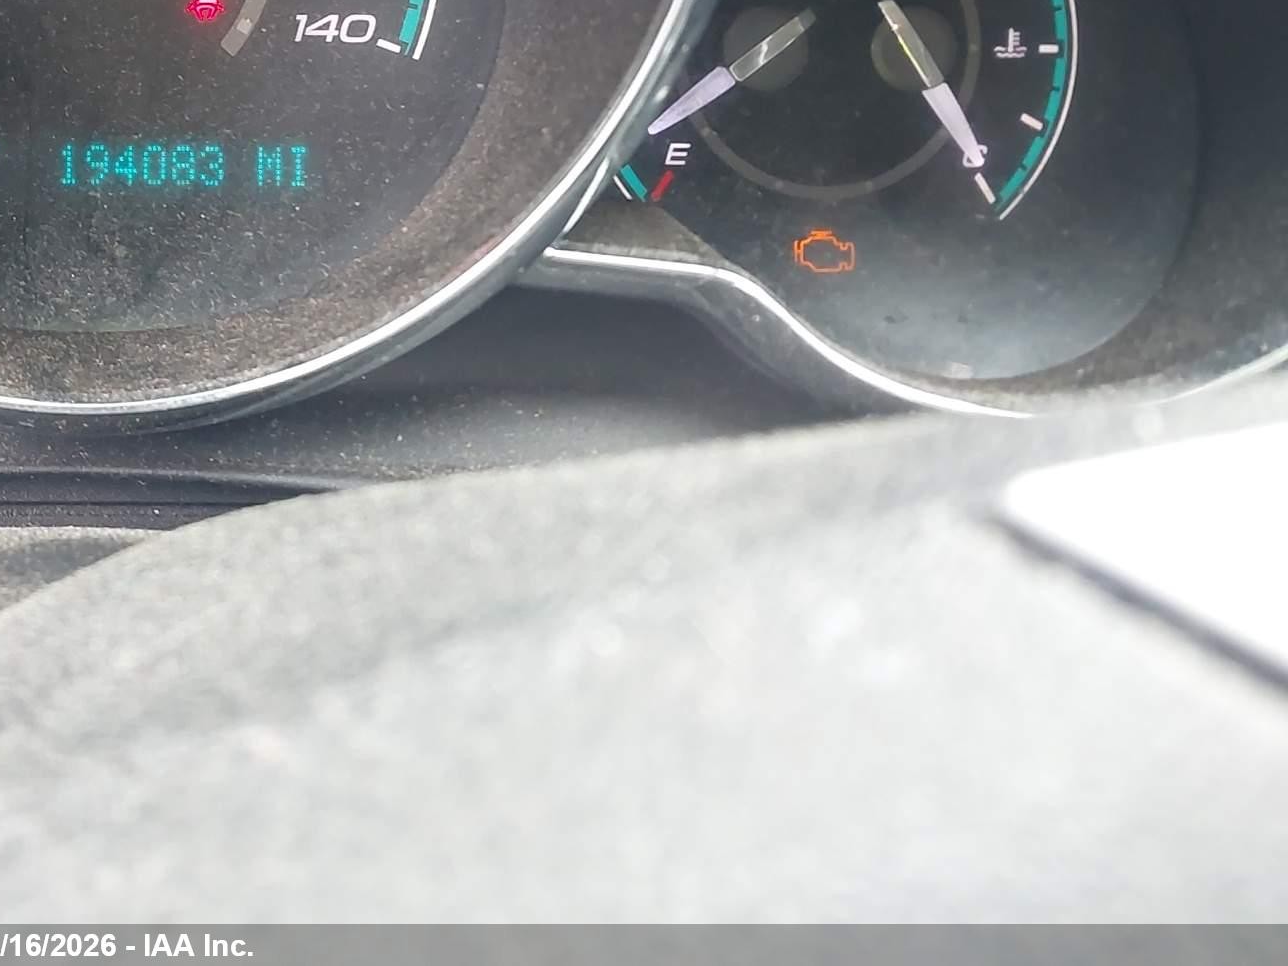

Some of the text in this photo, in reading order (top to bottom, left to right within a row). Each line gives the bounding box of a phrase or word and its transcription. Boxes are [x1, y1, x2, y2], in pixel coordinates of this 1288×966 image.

[294, 13, 376, 43] 140
[62, 144, 307, 187] 194083 MI
[665, 142, 691, 166] E
